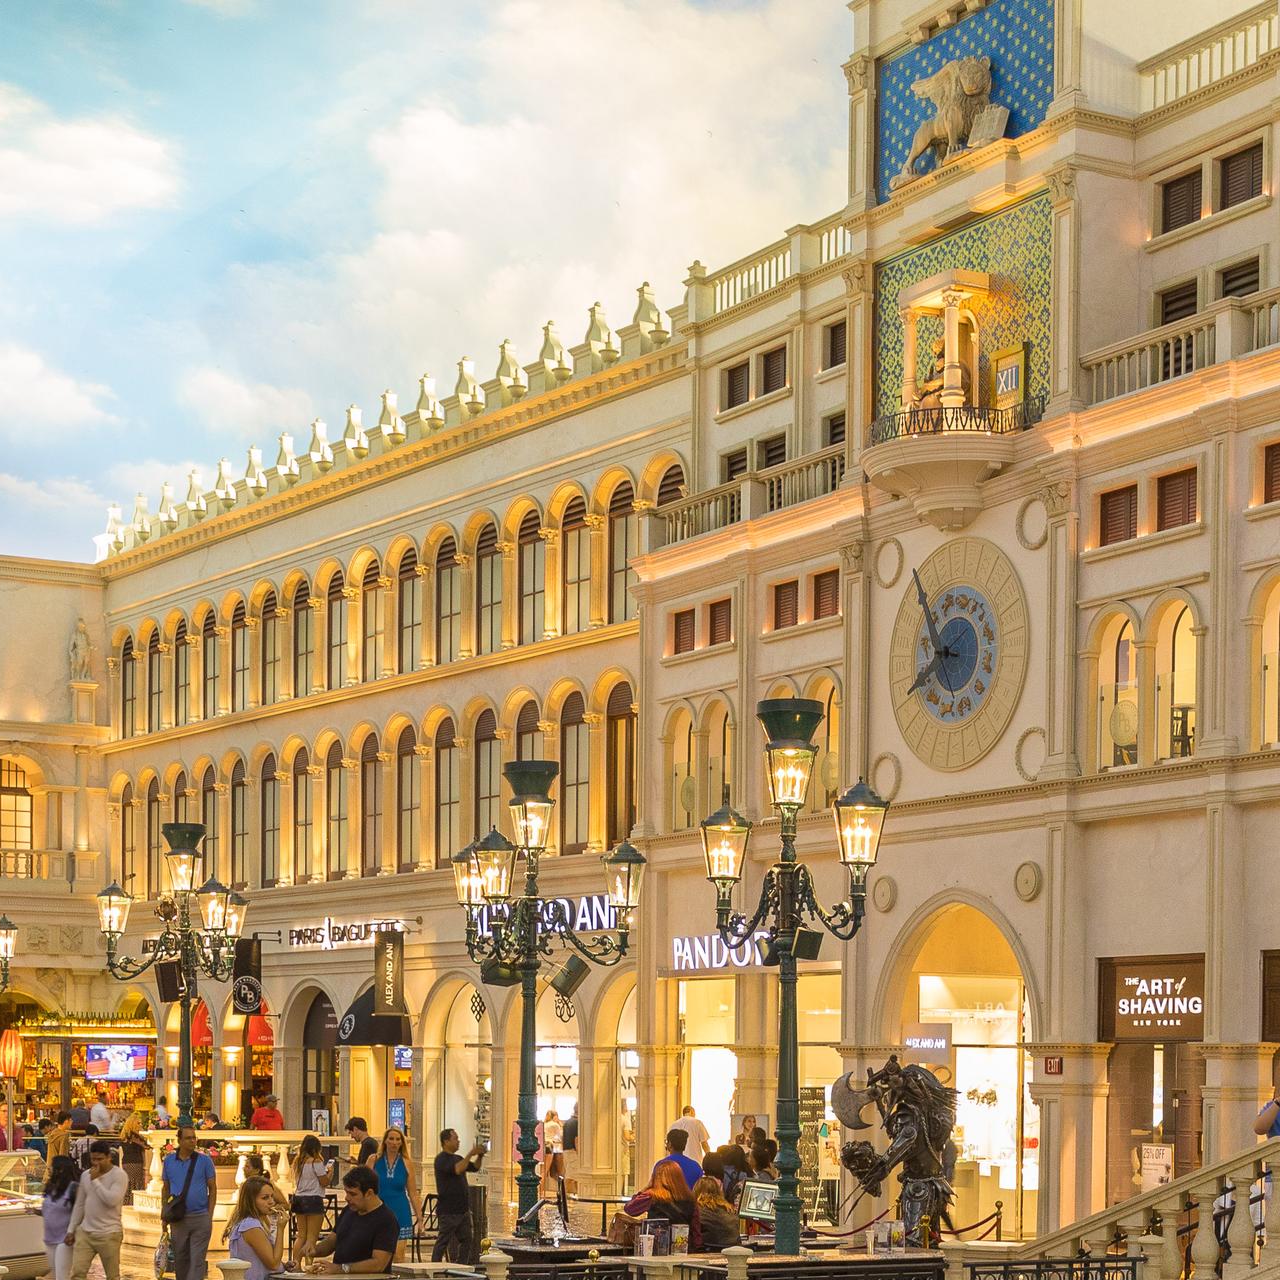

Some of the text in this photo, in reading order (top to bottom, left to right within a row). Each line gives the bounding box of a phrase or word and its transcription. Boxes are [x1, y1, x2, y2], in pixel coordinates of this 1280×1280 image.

[997, 367, 1016, 395] XII
[289, 926, 325, 946] PARIS
[673, 931, 773, 970] PANDOR
[385, 943, 394, 1006] ALEX AND ANI
[241, 985, 255, 1003] PB
[1124, 977, 1140, 986] THE
[1136, 979, 1174, 996] ART
[1118, 997, 1203, 1015] SHAVING
[1048, 1059, 1060, 1072] EXIT
[537, 1074, 572, 1090] ALEX
[1155, 1148, 1166, 1160] OFF
